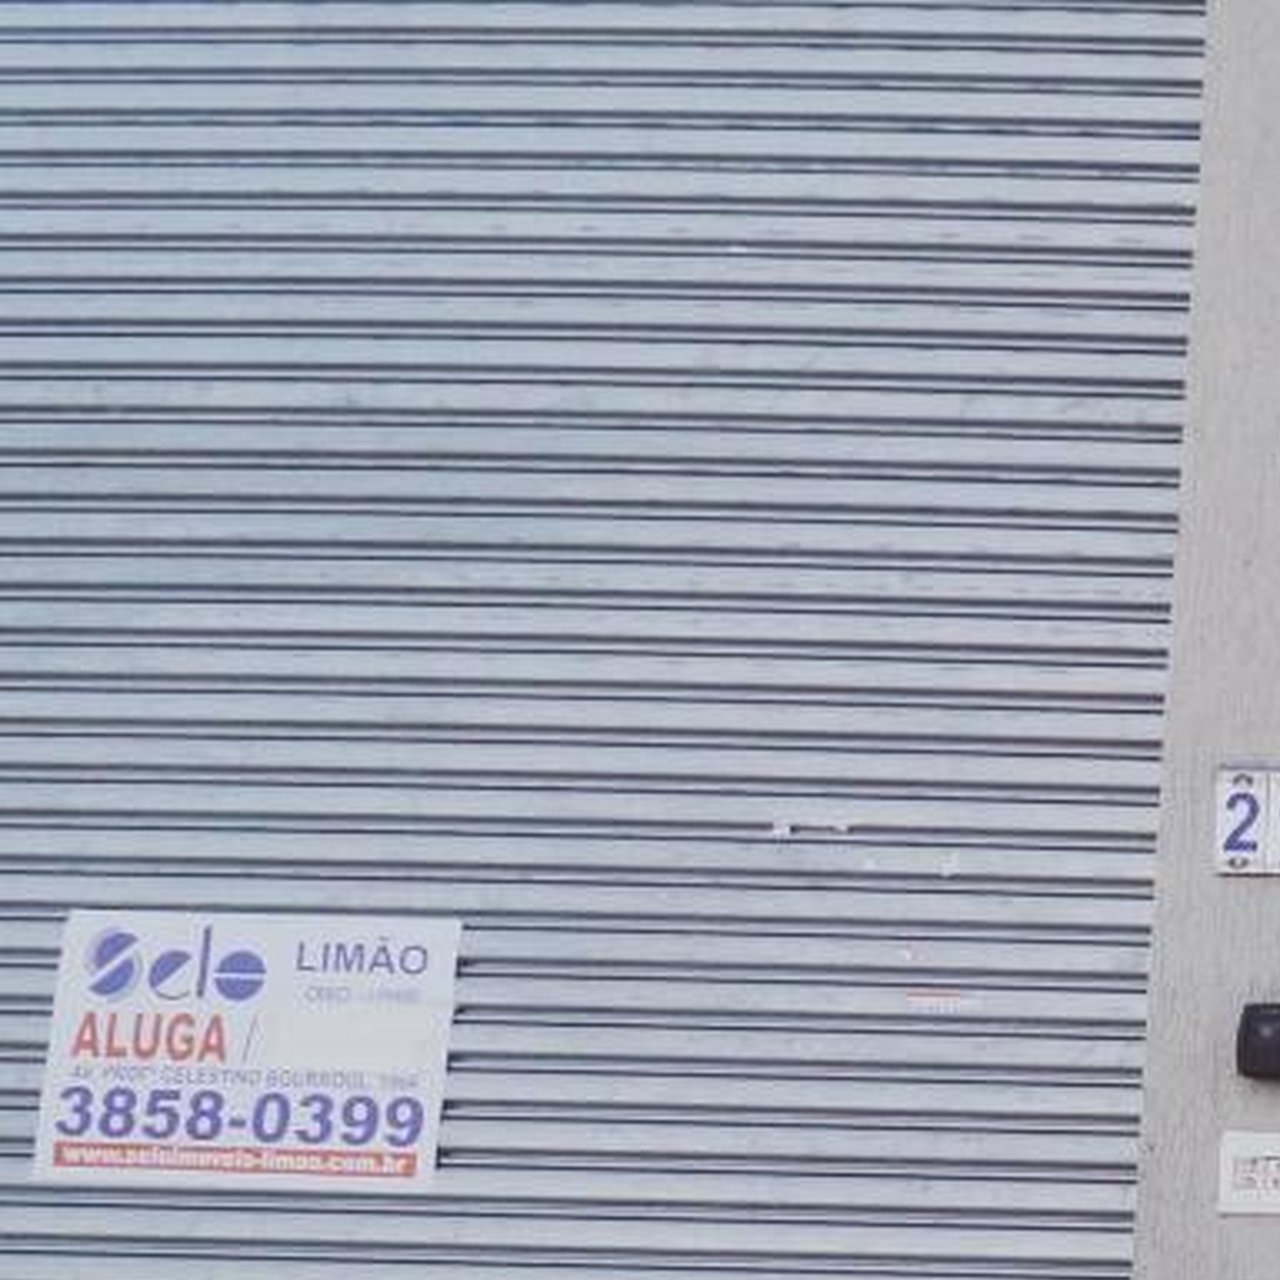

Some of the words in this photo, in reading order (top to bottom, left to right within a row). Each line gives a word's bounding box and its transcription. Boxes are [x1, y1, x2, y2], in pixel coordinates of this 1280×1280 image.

[296, 936, 428, 975] LIMÃO
[71, 1011, 228, 1063] ALUGA
[55, 1086, 425, 1147] 3858-0399
